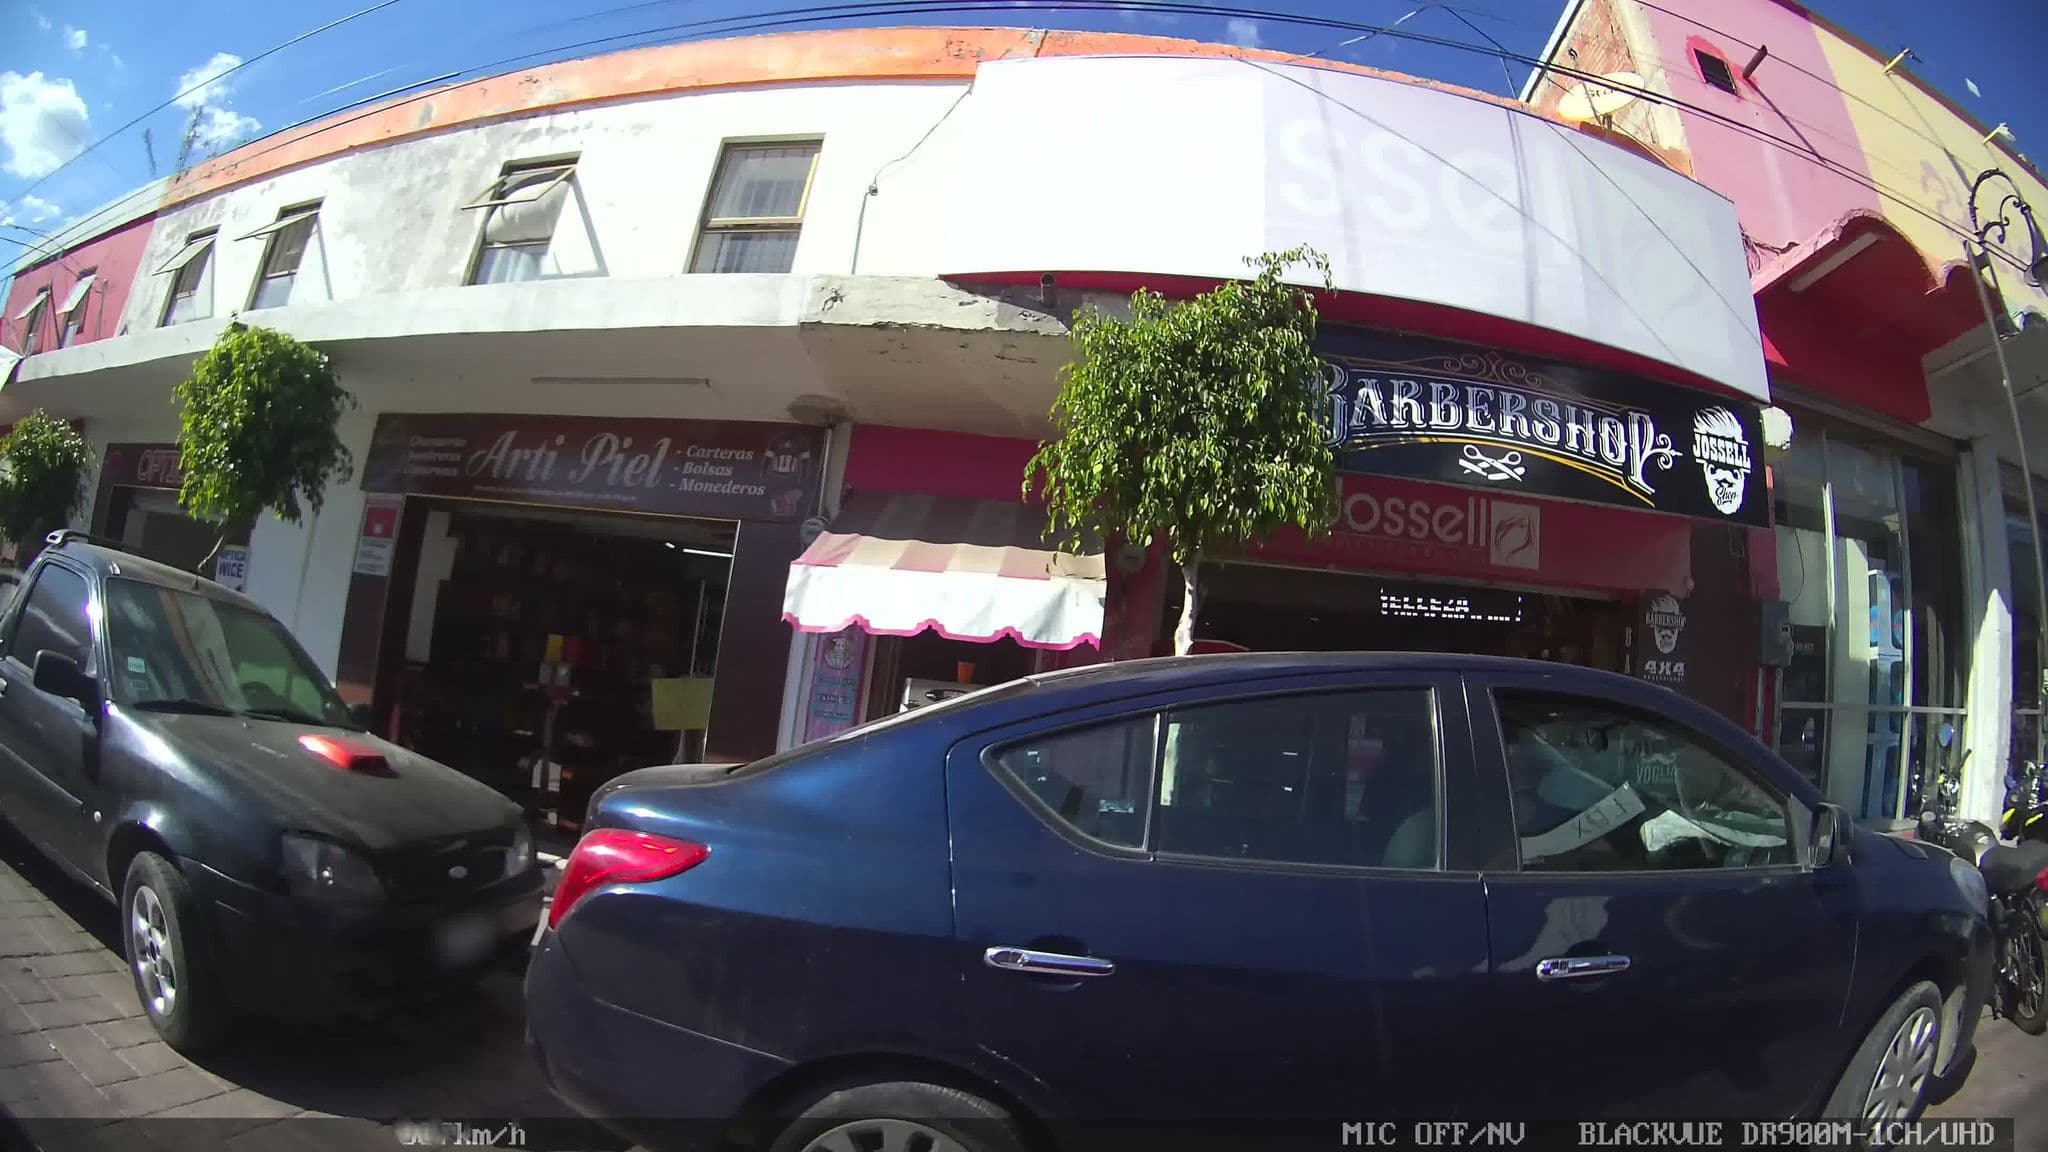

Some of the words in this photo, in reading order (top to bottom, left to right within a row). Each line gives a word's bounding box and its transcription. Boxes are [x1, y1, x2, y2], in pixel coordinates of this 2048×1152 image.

[1314, 362, 1676, 496] BARBERSHOP
[466, 430, 567, 480] Arti
[569, 431, 673, 490] Piel
[686, 444, 754, 461] Carteras
[1692, 431, 1752, 474] JOSSELL
[682, 461, 733, 477] Bolsas
[676, 478, 766, 496] Monederos
